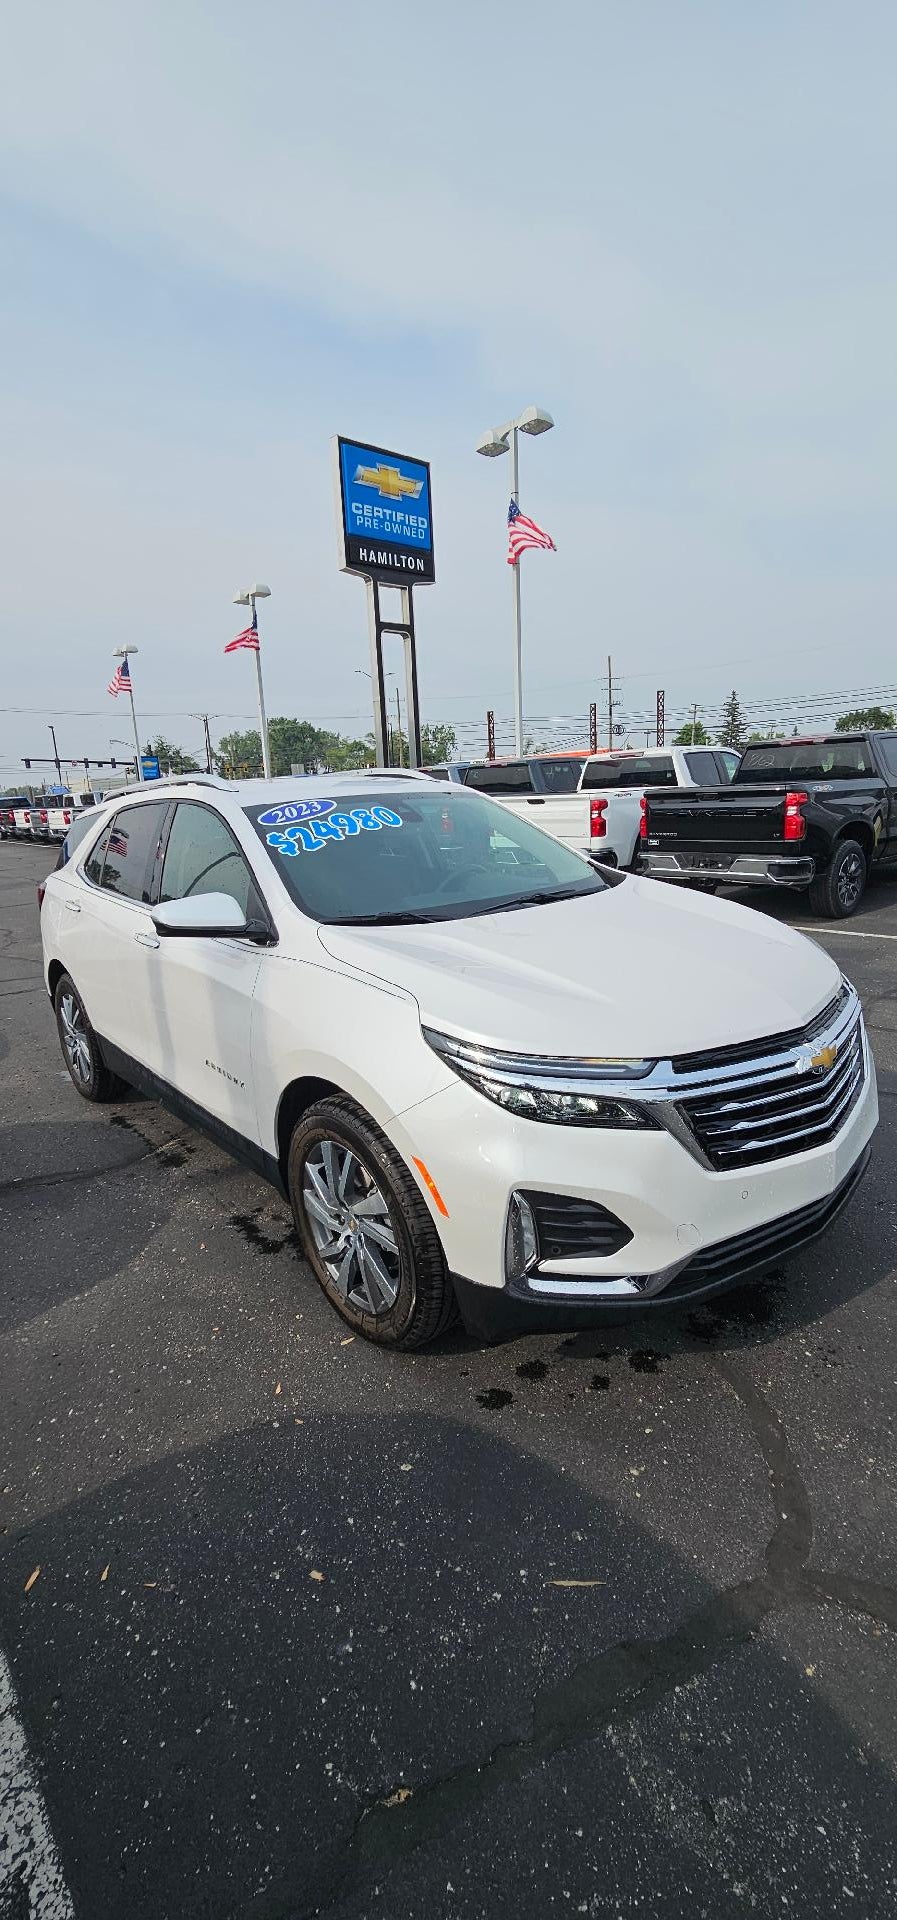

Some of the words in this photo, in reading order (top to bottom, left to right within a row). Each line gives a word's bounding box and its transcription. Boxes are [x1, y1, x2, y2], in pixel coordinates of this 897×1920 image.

[351, 502, 428, 529] CERTIFIED
[356, 515, 425, 539] PRE-OWNED
[359, 547, 425, 572] HAMILTON
[271, 801, 322, 823] 2023
[266, 806, 403, 857] $24980
